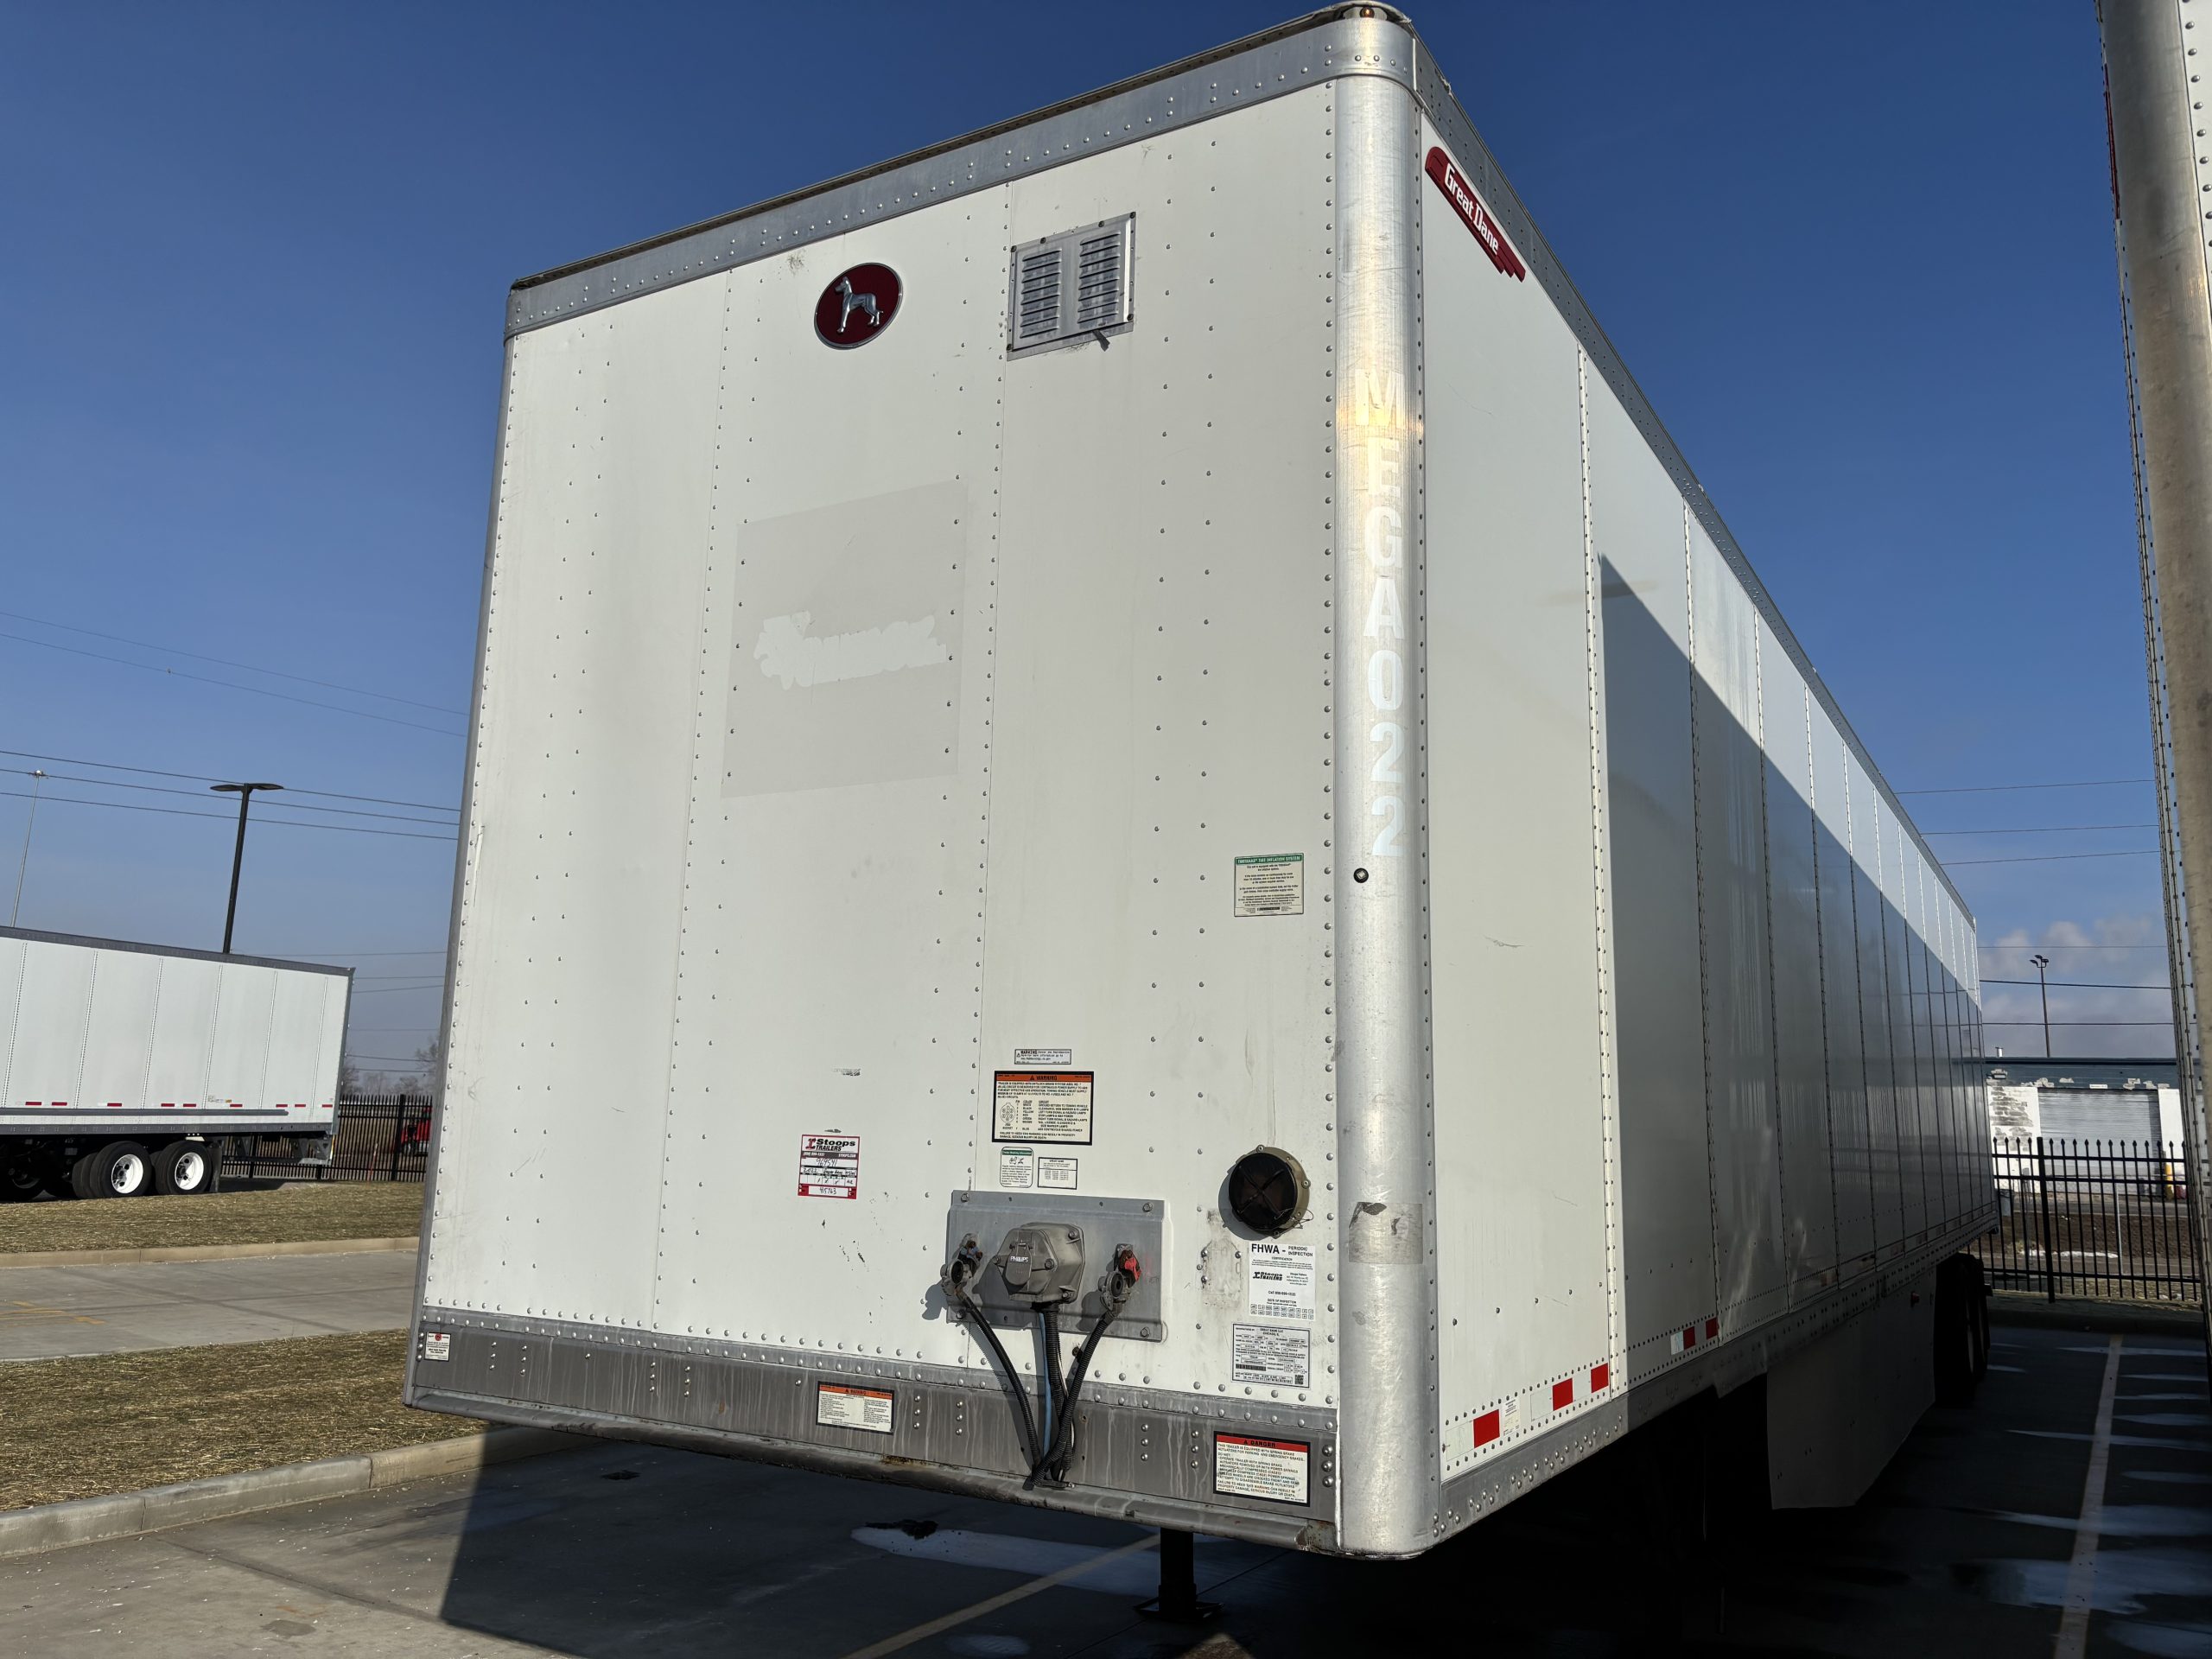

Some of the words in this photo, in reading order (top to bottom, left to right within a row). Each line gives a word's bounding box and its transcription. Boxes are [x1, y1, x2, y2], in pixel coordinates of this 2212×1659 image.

[1444, 162, 1477, 221] Great
[1472, 203, 1499, 255] Dane
[1251, 1243, 1280, 1254] FHWA
